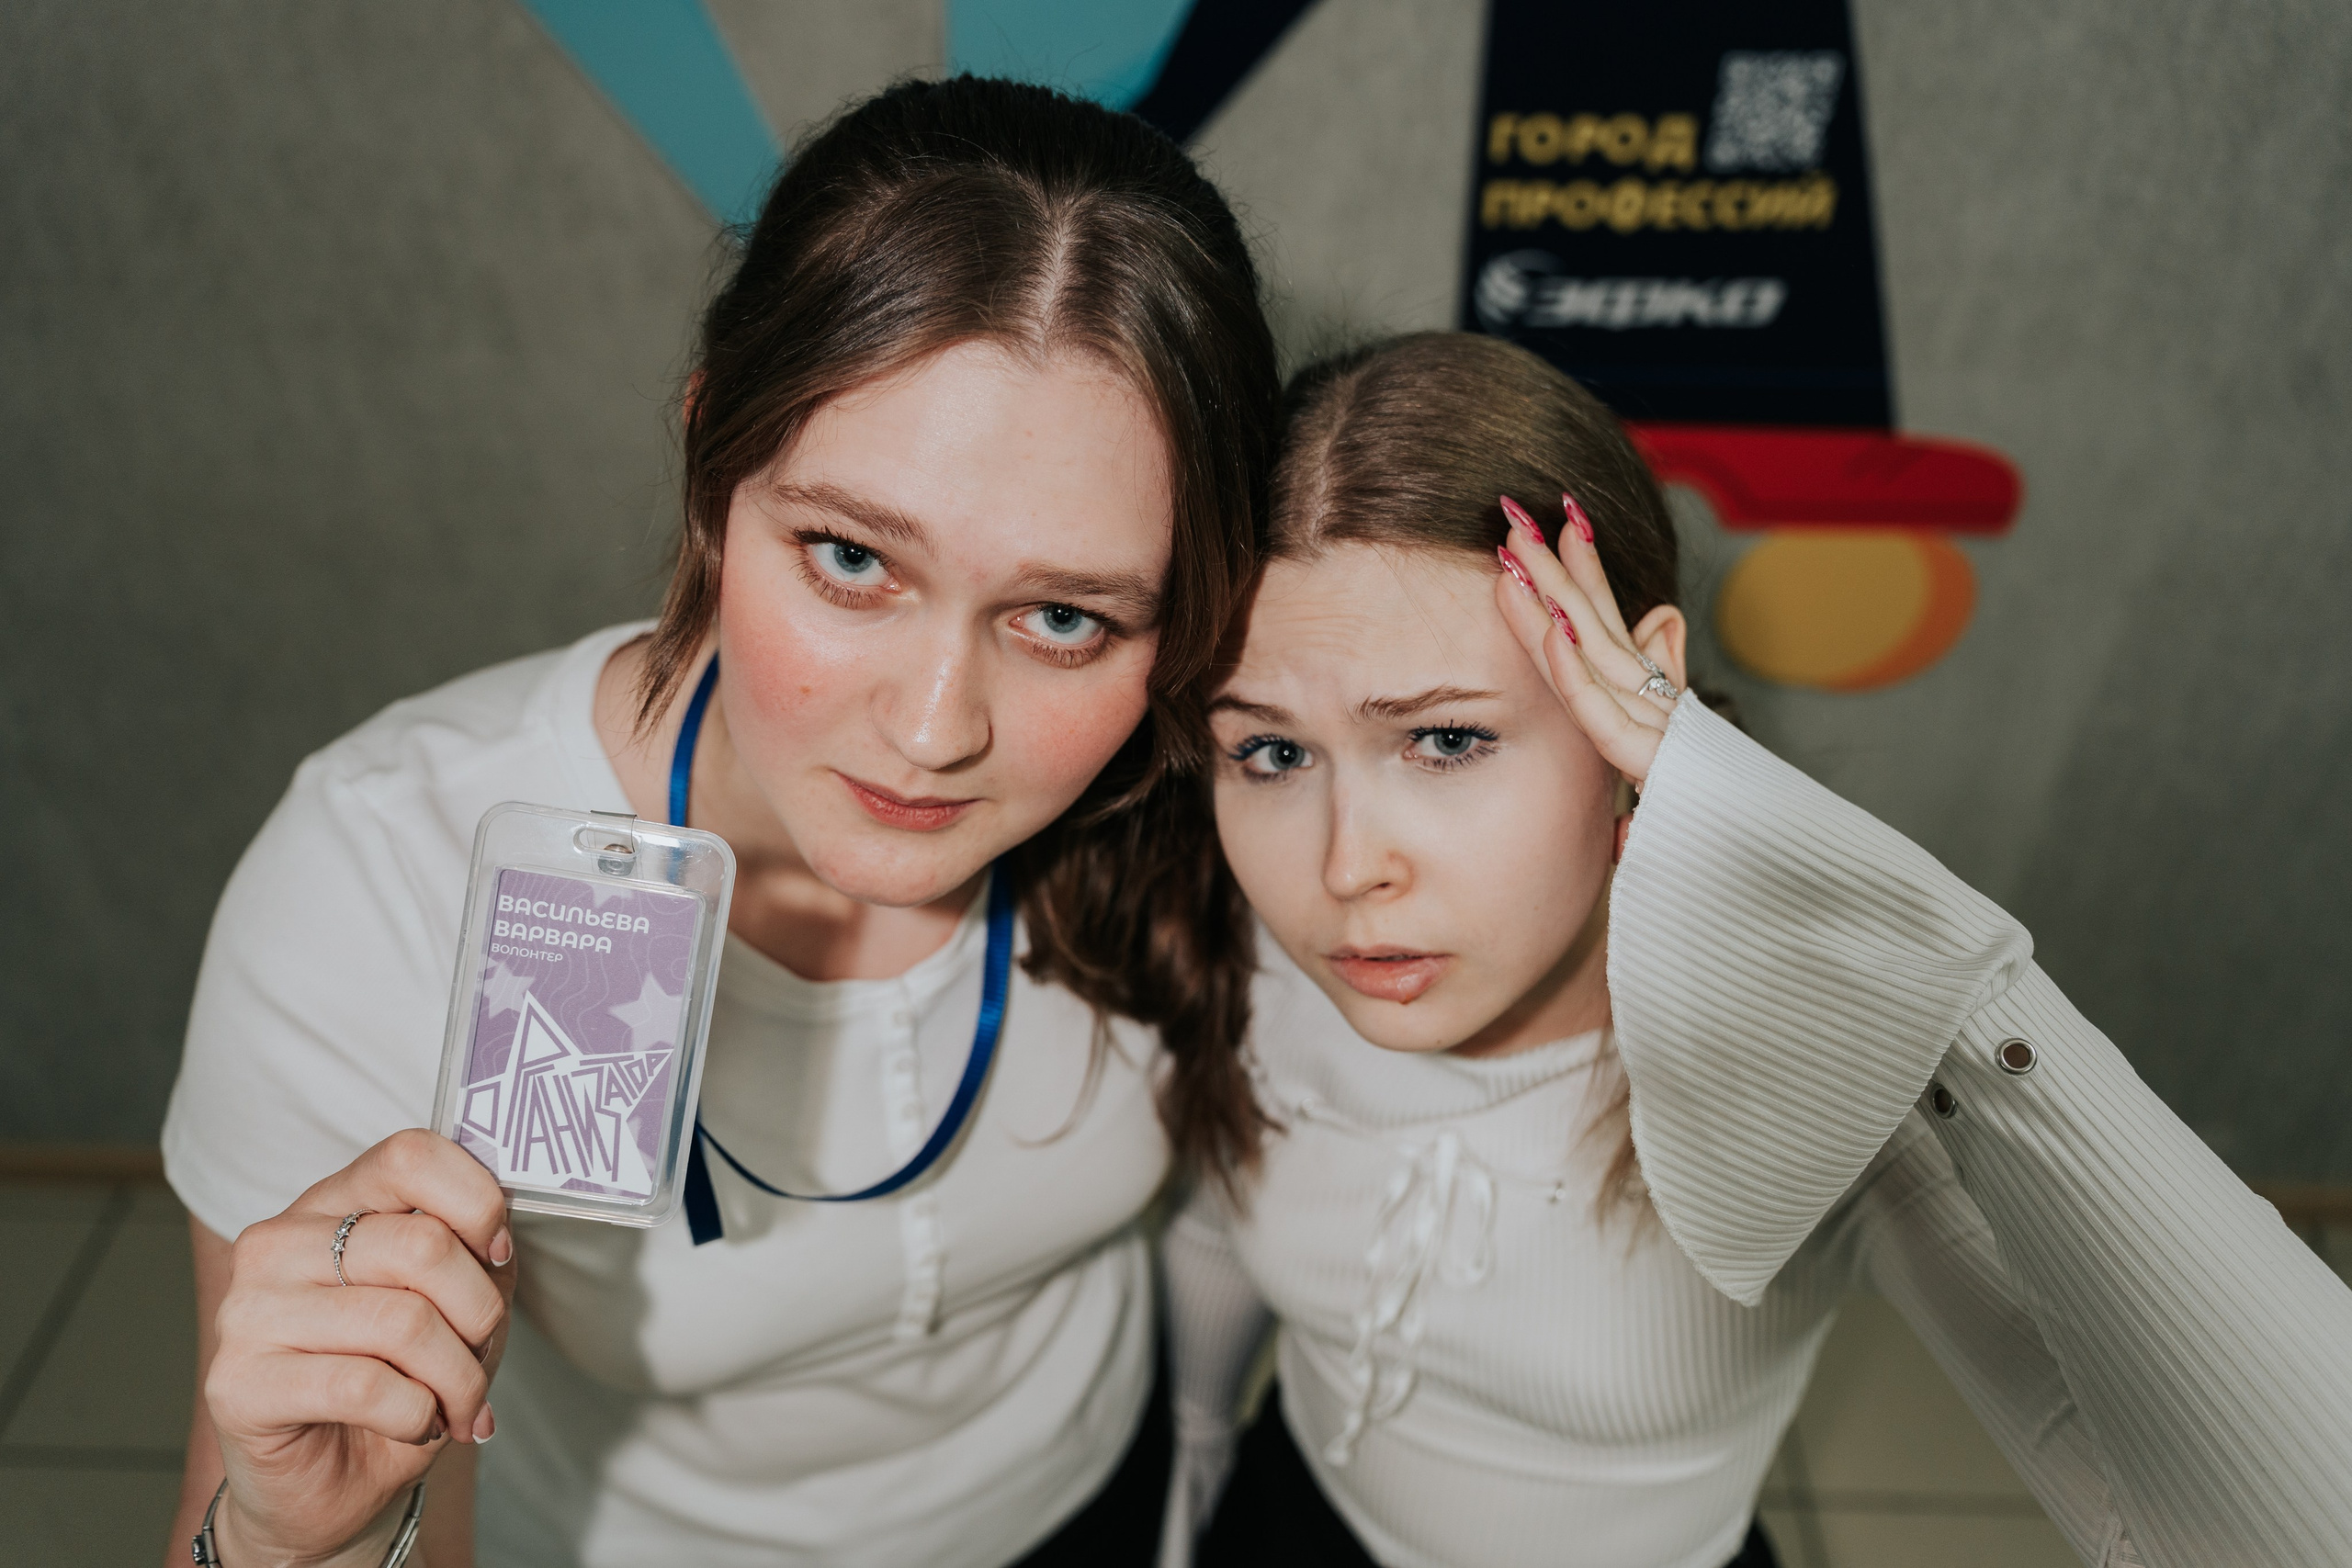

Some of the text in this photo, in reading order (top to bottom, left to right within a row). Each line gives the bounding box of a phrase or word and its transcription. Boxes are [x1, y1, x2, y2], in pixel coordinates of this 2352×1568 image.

[1488, 113, 1697, 173] ГОРОД
[1482, 173, 1837, 234] ПРОФЕССИЙ
[498, 895, 650, 933] ВАСИЛЬЕВА
[492, 943, 563, 962] ВОЛОНТЕР
[493, 919, 612, 953] ВАРВАРА
